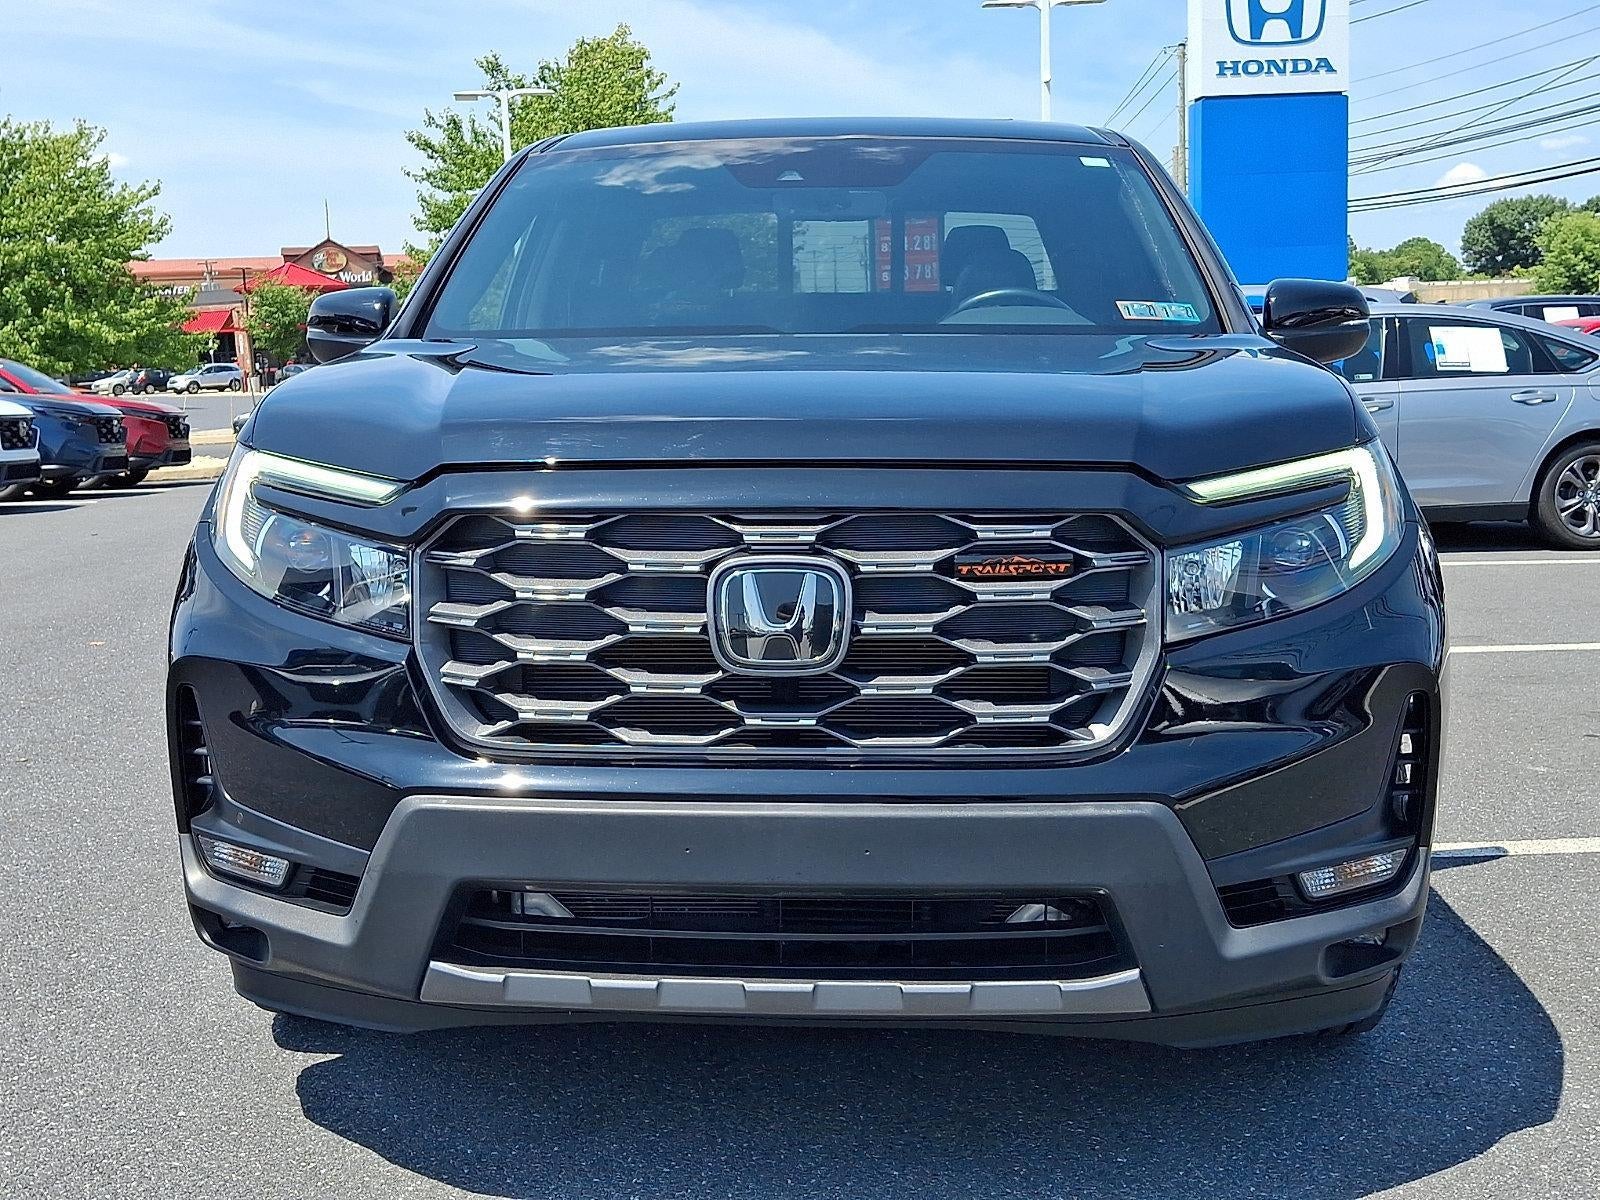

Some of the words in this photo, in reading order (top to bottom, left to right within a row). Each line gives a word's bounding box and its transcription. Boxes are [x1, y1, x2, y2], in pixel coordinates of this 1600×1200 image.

[1216, 58, 1337, 77] HONDA
[339, 271, 372, 282] World
[957, 563, 1071, 576] TRAILSPORT
